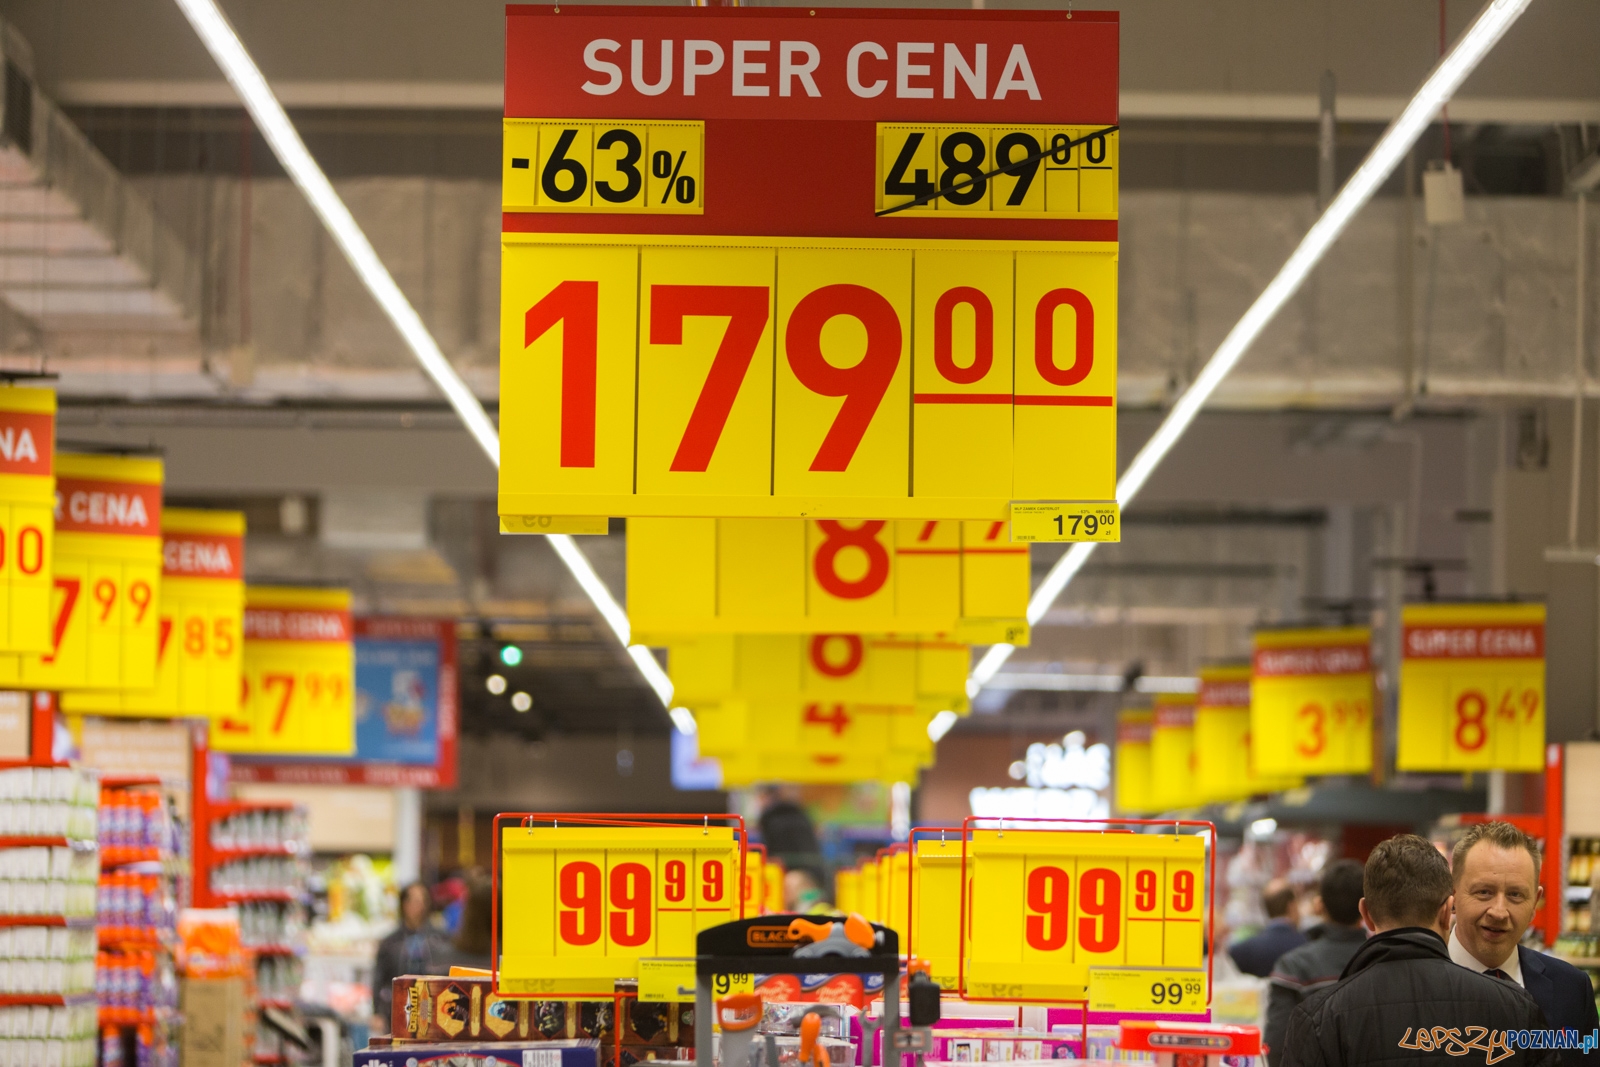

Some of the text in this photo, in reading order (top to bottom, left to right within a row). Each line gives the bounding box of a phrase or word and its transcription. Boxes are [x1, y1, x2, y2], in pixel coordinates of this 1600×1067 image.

[581, 38, 1043, 100] SUPER CENA
[511, 128, 696, 204] -63%
[69, 489, 149, 528] CENA
